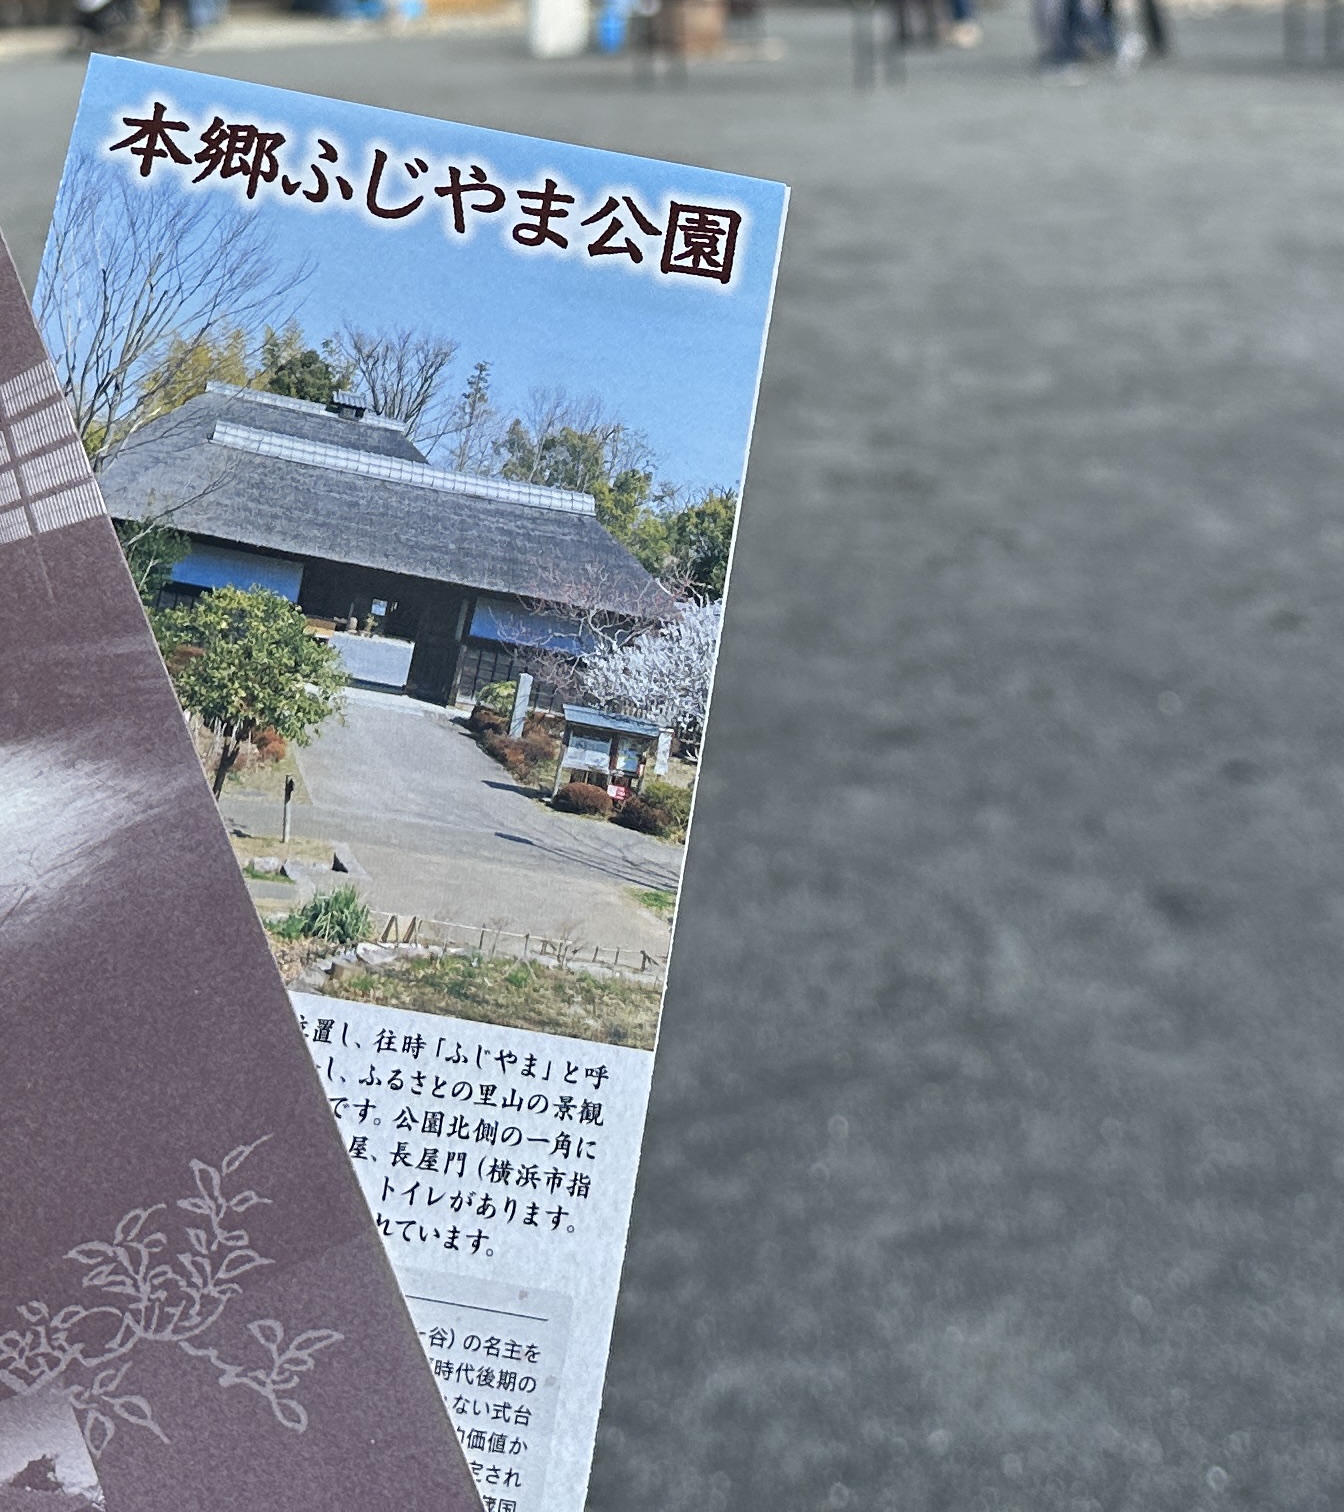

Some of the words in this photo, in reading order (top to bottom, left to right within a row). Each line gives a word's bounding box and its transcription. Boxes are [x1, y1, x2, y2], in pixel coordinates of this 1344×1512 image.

[109, 102, 742, 284] 本郷ふじやま公園
[316, 1056, 604, 1126] し、ふるさとの里山の景観
[329, 1096, 597, 1160] です。公園北側の一角に
[381, 1176, 575, 1233] トイレがあります。
[419, 1326, 541, 1363] 谷)の名主を
[429, 1357, 537, 1393] 時代後期の
[444, 1394, 532, 1426] ない式台
